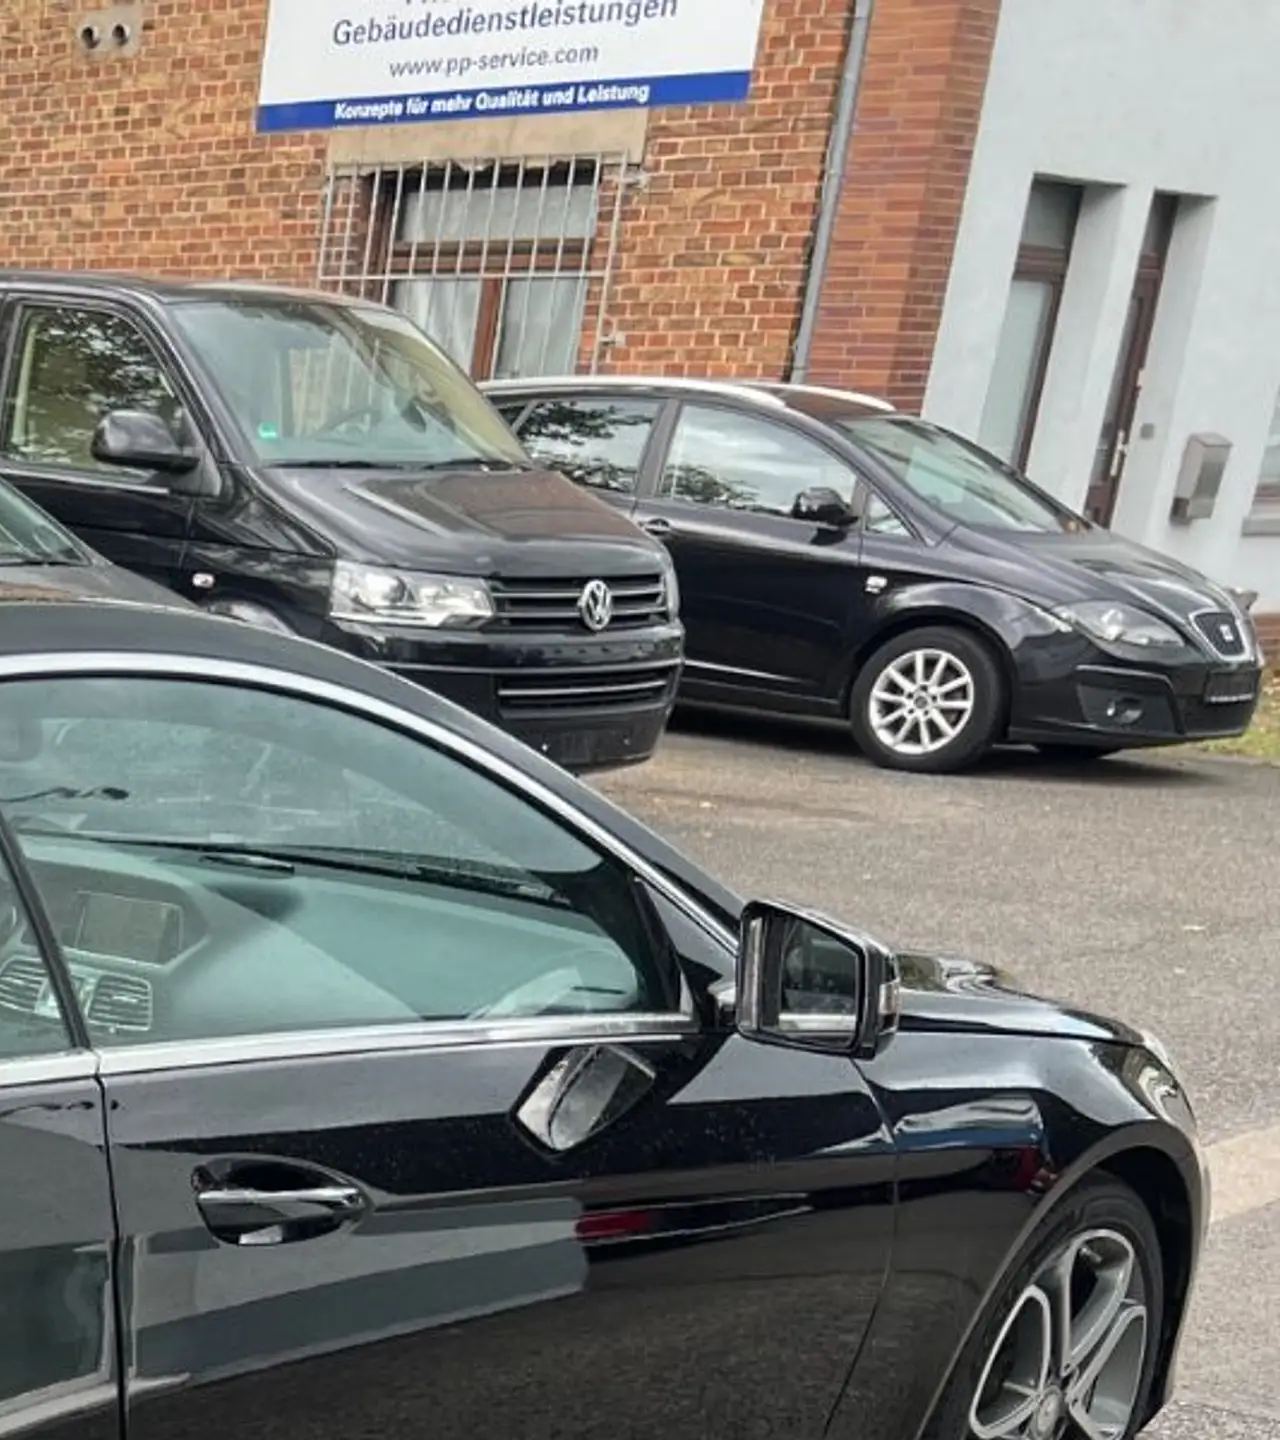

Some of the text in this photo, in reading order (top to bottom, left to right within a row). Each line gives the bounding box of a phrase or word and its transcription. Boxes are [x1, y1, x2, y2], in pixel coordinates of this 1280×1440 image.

[333, 0, 677, 46] Gebäudedienstleistungen
[335, 84, 650, 121] Konzepte für mehr Qualität und Leistung
